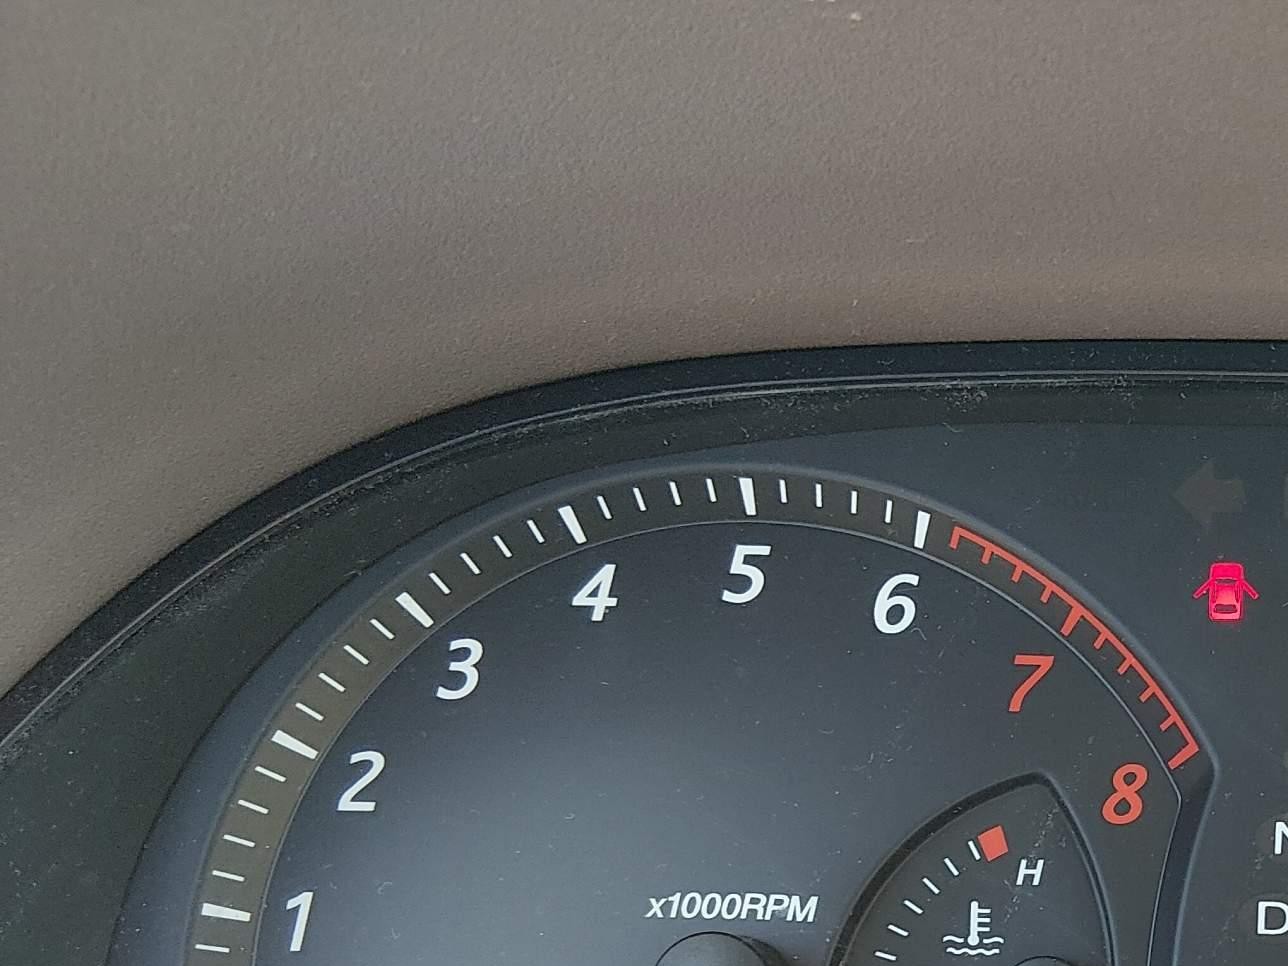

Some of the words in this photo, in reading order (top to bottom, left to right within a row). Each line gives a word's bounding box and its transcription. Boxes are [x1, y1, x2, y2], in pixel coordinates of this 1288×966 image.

[571, 563, 618, 621] 4
[721, 544, 772, 604] 5
[872, 573, 919, 634] 6
[436, 638, 484, 700] 3
[1008, 654, 1054, 712] 7
[336, 750, 385, 812] 2
[1102, 763, 1148, 825] 8
[1015, 859, 1044, 886] H
[285, 891, 314, 952] 1
[644, 891, 819, 923] x1000RPM
